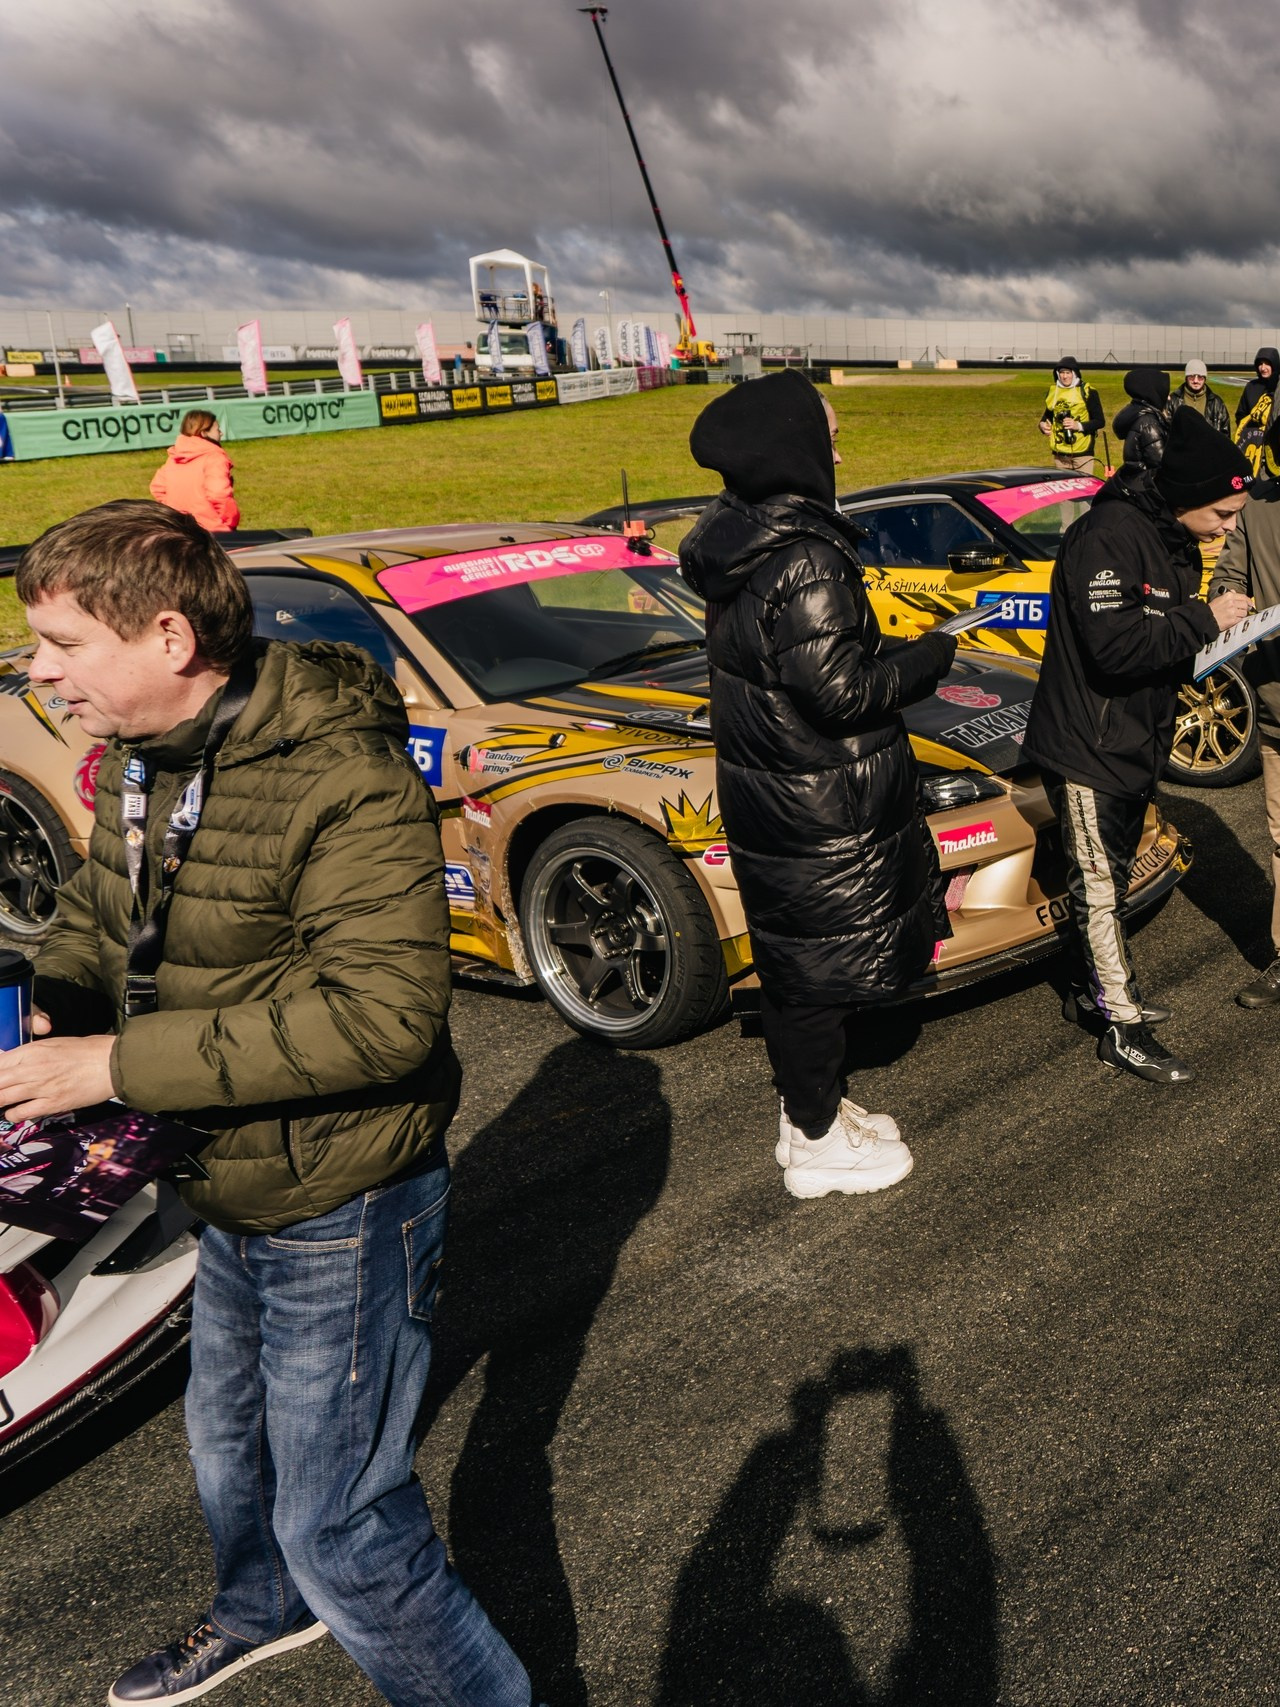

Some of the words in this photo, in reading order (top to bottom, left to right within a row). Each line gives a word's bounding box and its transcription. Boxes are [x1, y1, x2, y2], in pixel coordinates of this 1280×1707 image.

[443, 557, 495, 573] RUSSIAN
[498, 546, 582, 573] RDS
[573, 543, 606, 557] GP
[463, 563, 496, 575] DRIFT
[460, 570, 501, 583] SERIES
[1089, 579, 1120, 587] LINGLONG
[876, 580, 948, 593] KASHIYAMA
[1001, 599, 1043, 622] ВТБ
[478, 748, 525, 763] Standard
[477, 761, 511, 774] Springs
[622, 766, 663, 780] ТЕХМАРКЕТЫ
[626, 758, 694, 779] ВИРАЖ
[939, 831, 998, 855] Makita
